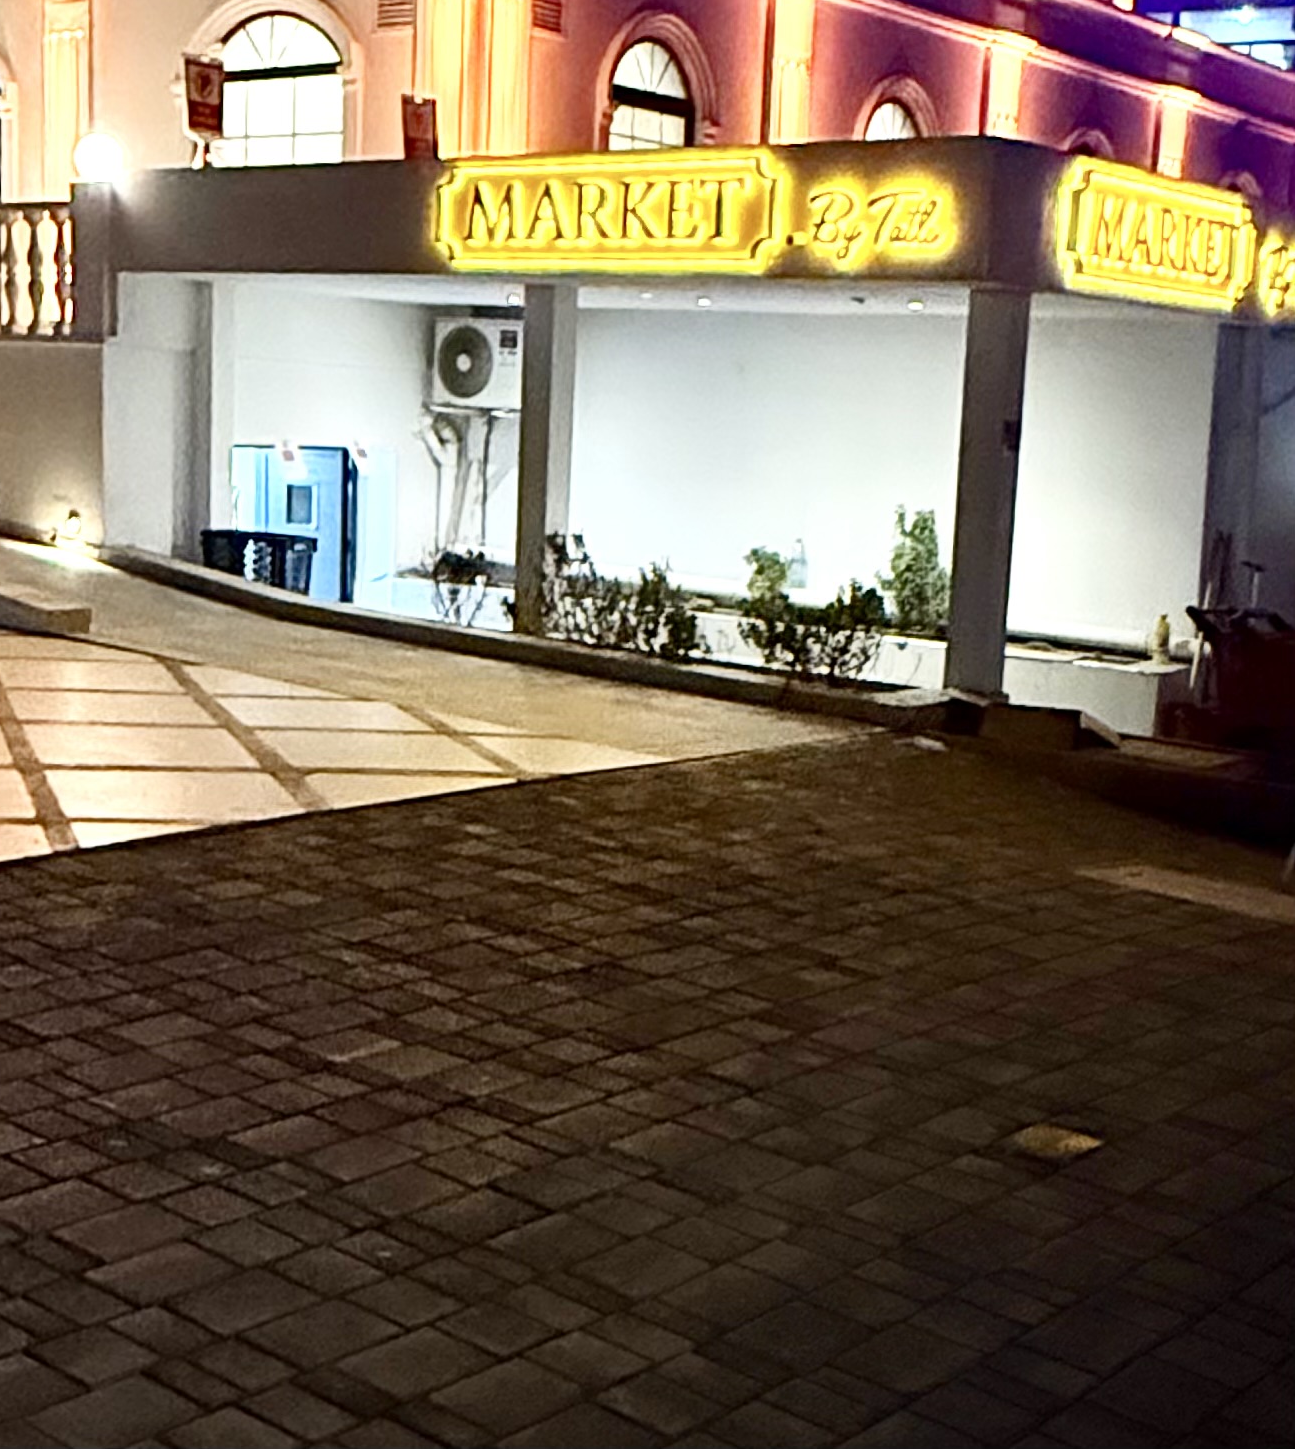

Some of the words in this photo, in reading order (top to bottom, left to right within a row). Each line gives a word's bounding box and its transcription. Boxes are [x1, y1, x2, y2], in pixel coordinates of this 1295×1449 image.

[468, 178, 744, 245] MARKET
[810, 191, 862, 260] By
[1091, 191, 1239, 280] MARKET
